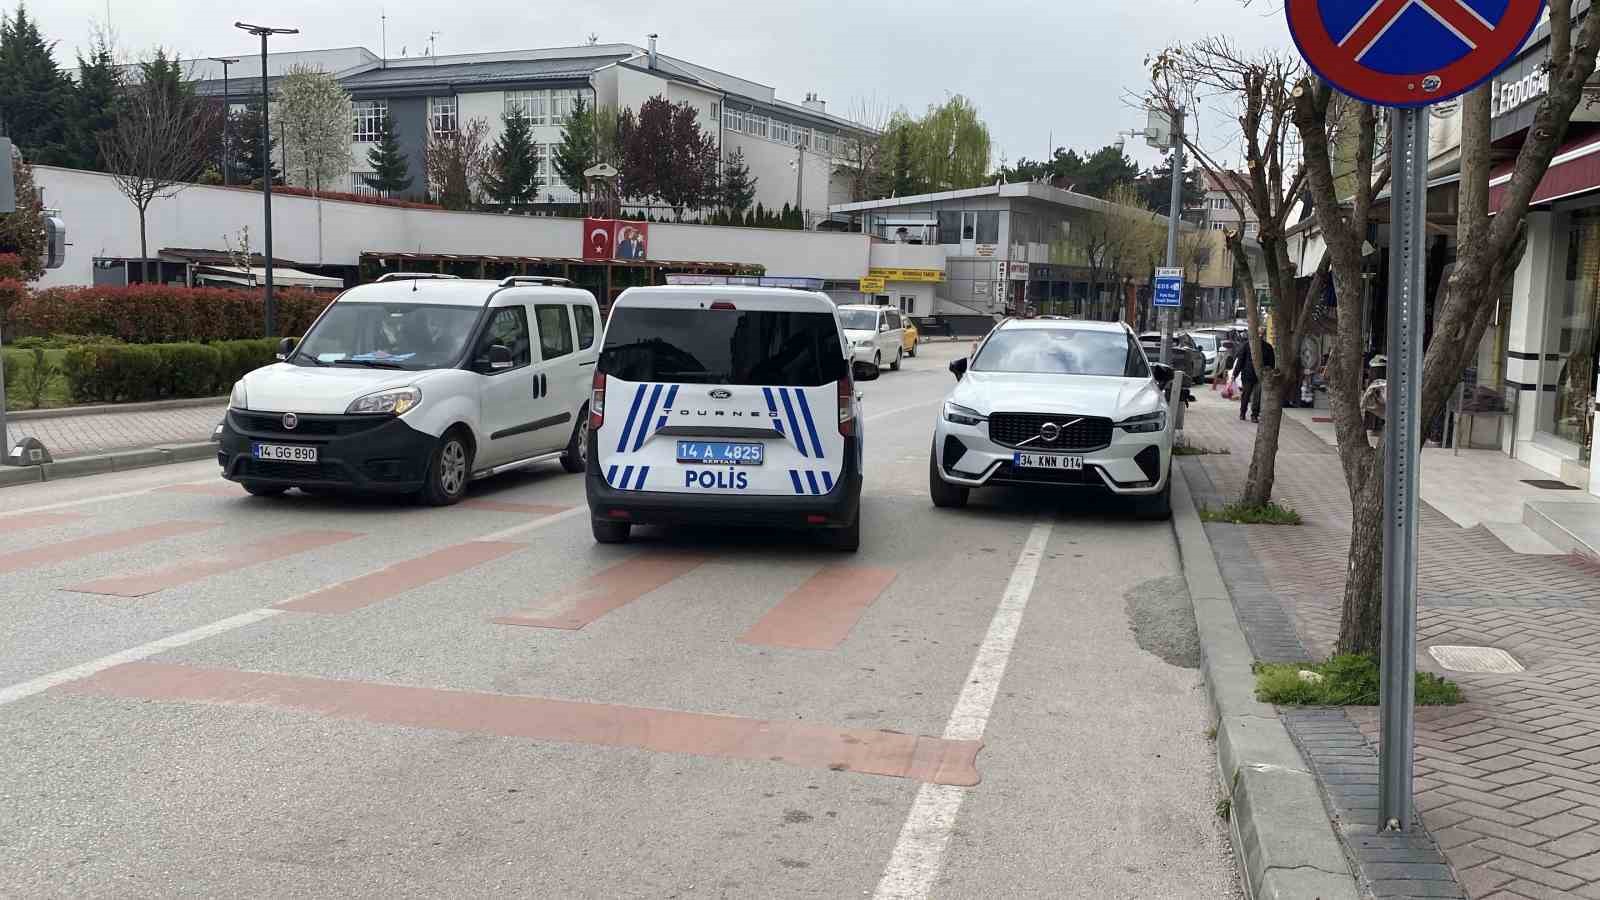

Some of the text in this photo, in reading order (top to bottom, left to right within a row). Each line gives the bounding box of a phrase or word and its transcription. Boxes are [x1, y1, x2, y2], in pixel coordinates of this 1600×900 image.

[663, 408, 778, 418] TOURNEO
[260, 446, 315, 460] 14 GG 890
[681, 444, 760, 460] 14 A 4825
[1020, 455, 1081, 468] 34 KNN 014
[685, 466, 748, 490] POLİS
